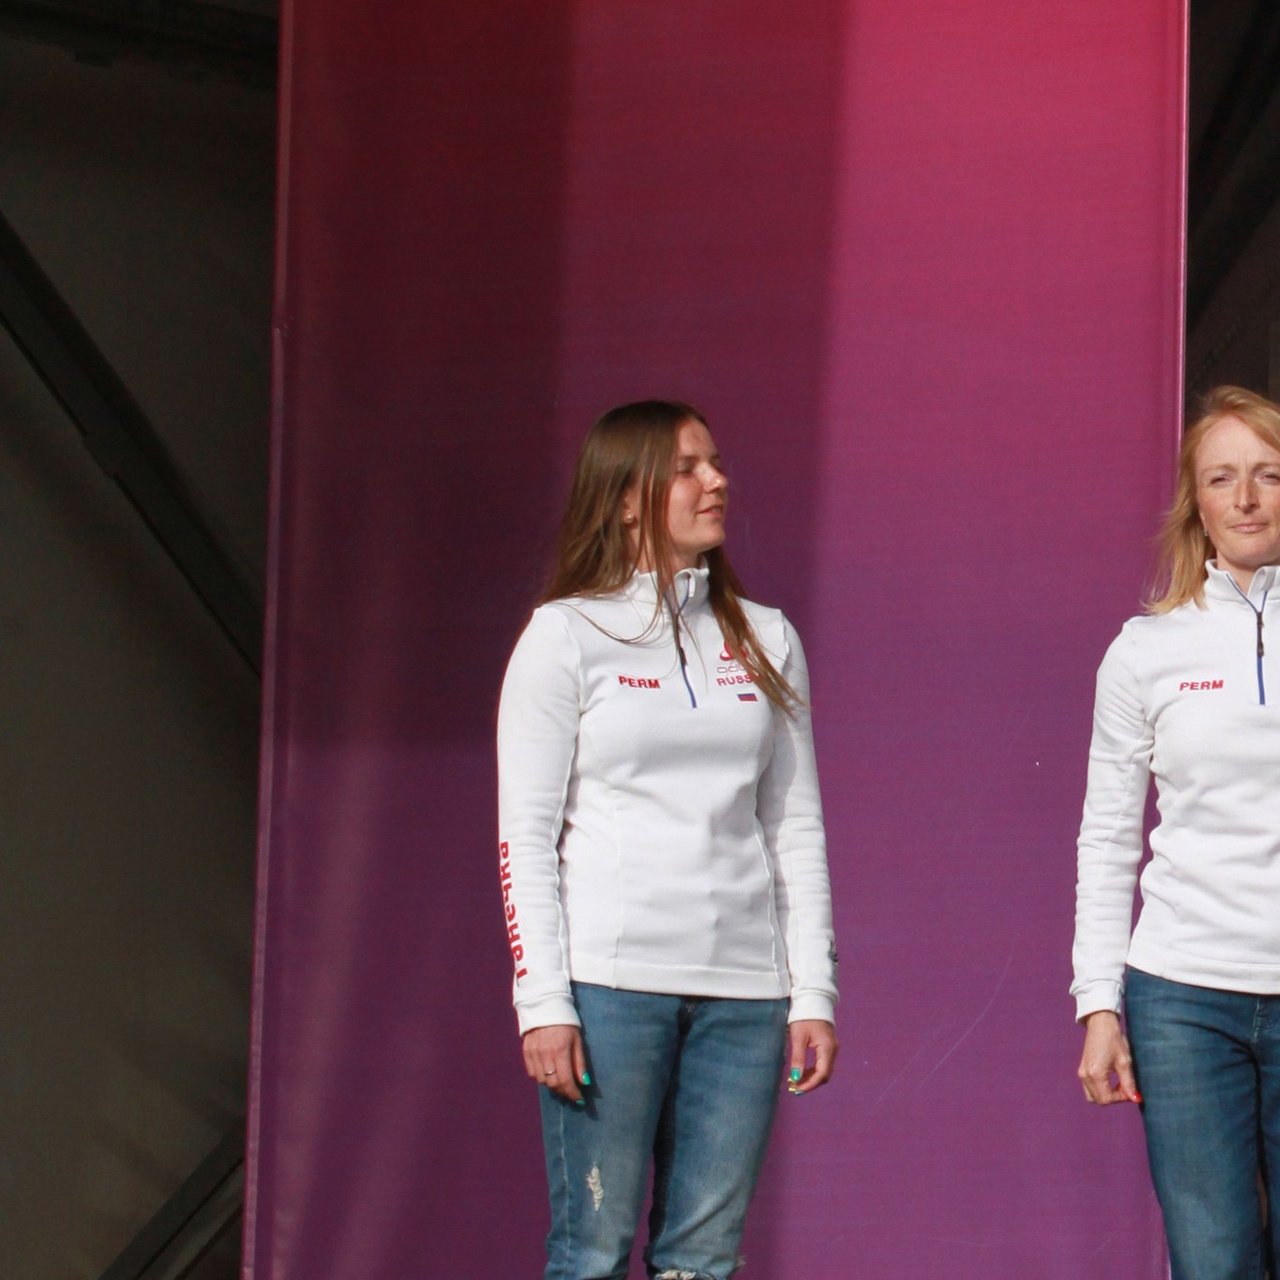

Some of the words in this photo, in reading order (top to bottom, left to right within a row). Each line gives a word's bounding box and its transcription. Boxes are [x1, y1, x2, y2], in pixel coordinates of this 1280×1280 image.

[716, 663, 746, 673] odl
[618, 675, 661, 689] PERM
[716, 673, 755, 686] RUSS
[1179, 680, 1224, 691] PERM
